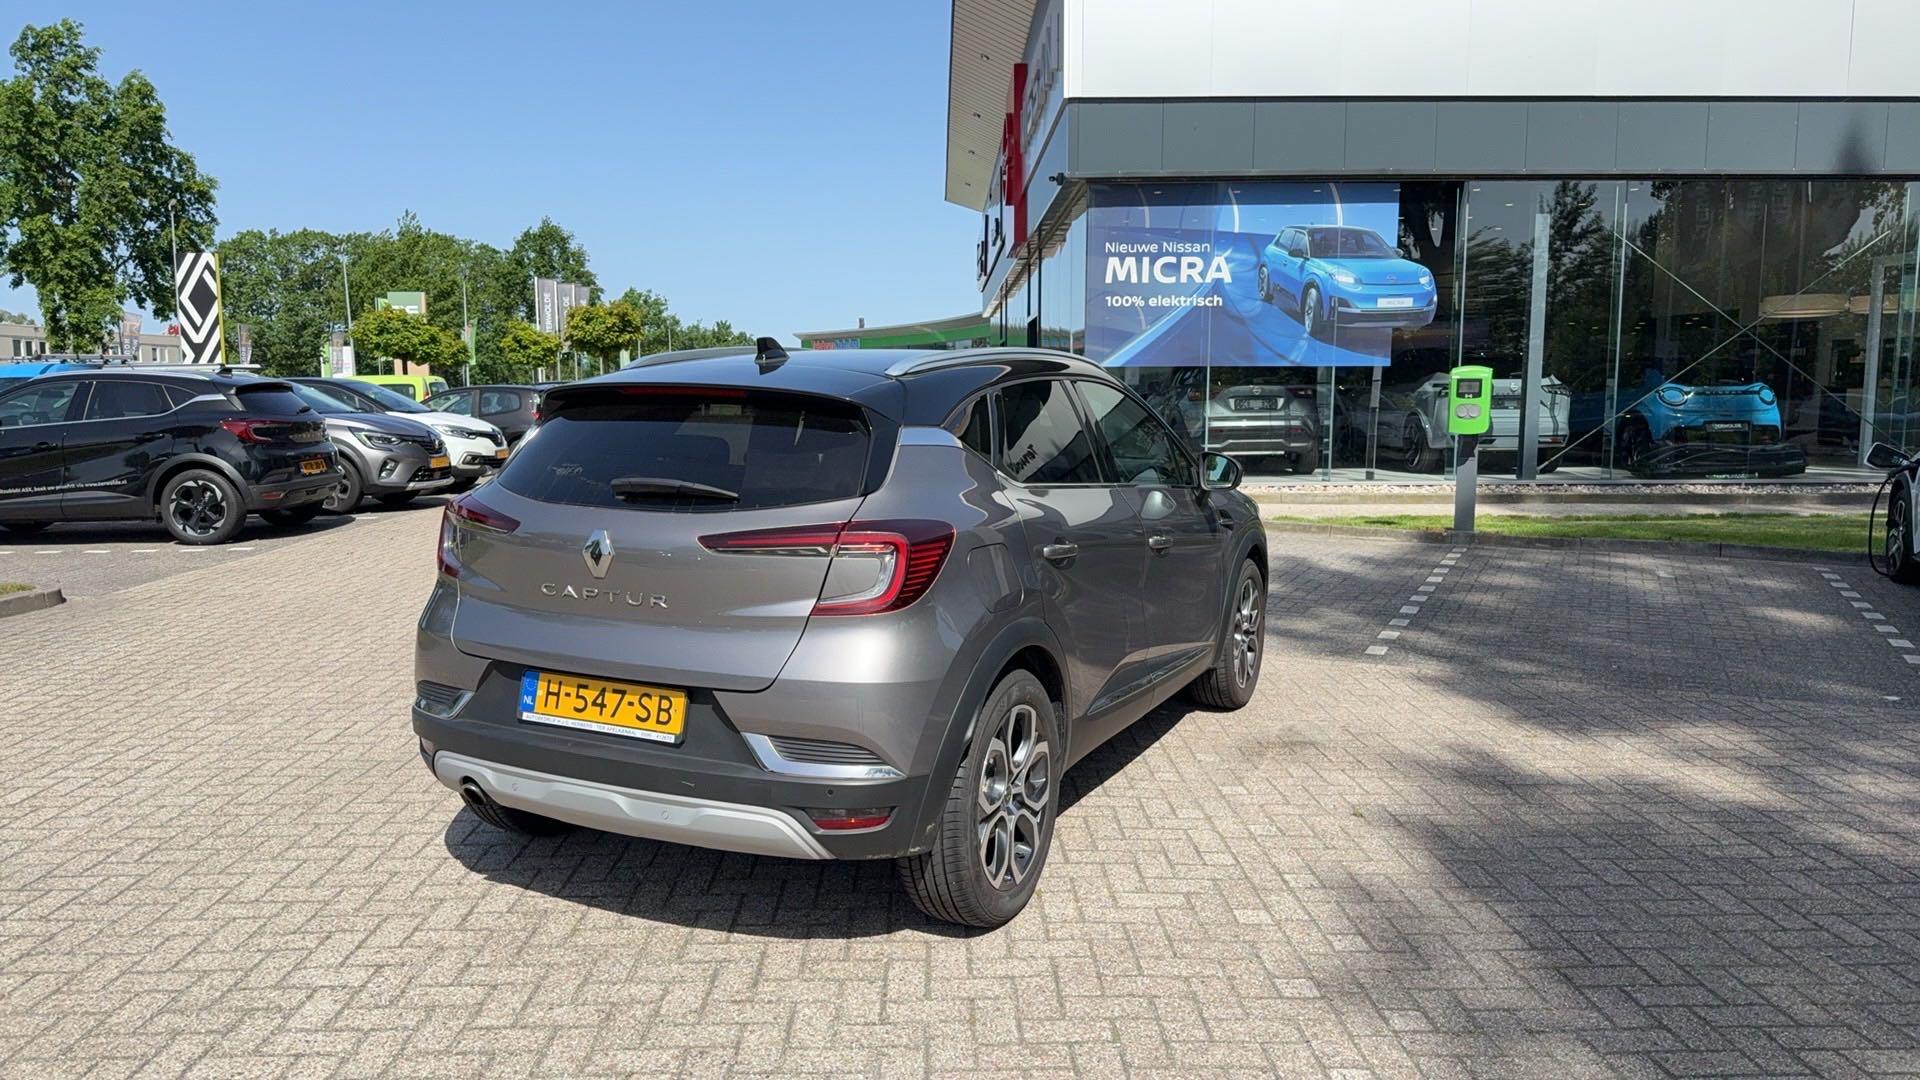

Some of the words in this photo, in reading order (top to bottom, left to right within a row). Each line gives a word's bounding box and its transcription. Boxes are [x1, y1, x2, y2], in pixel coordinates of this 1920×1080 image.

[1105, 242, 1158, 253] Nieuwe
[1162, 241, 1210, 253] Nissan
[1105, 256, 1232, 284] MICRA
[1105, 295, 1145, 307] 100%
[1148, 295, 1223, 307] elektrisch
[541, 583, 670, 609] CAPTUR
[523, 695, 533, 705] NL
[544, 679, 673, 725] H-547-SB
